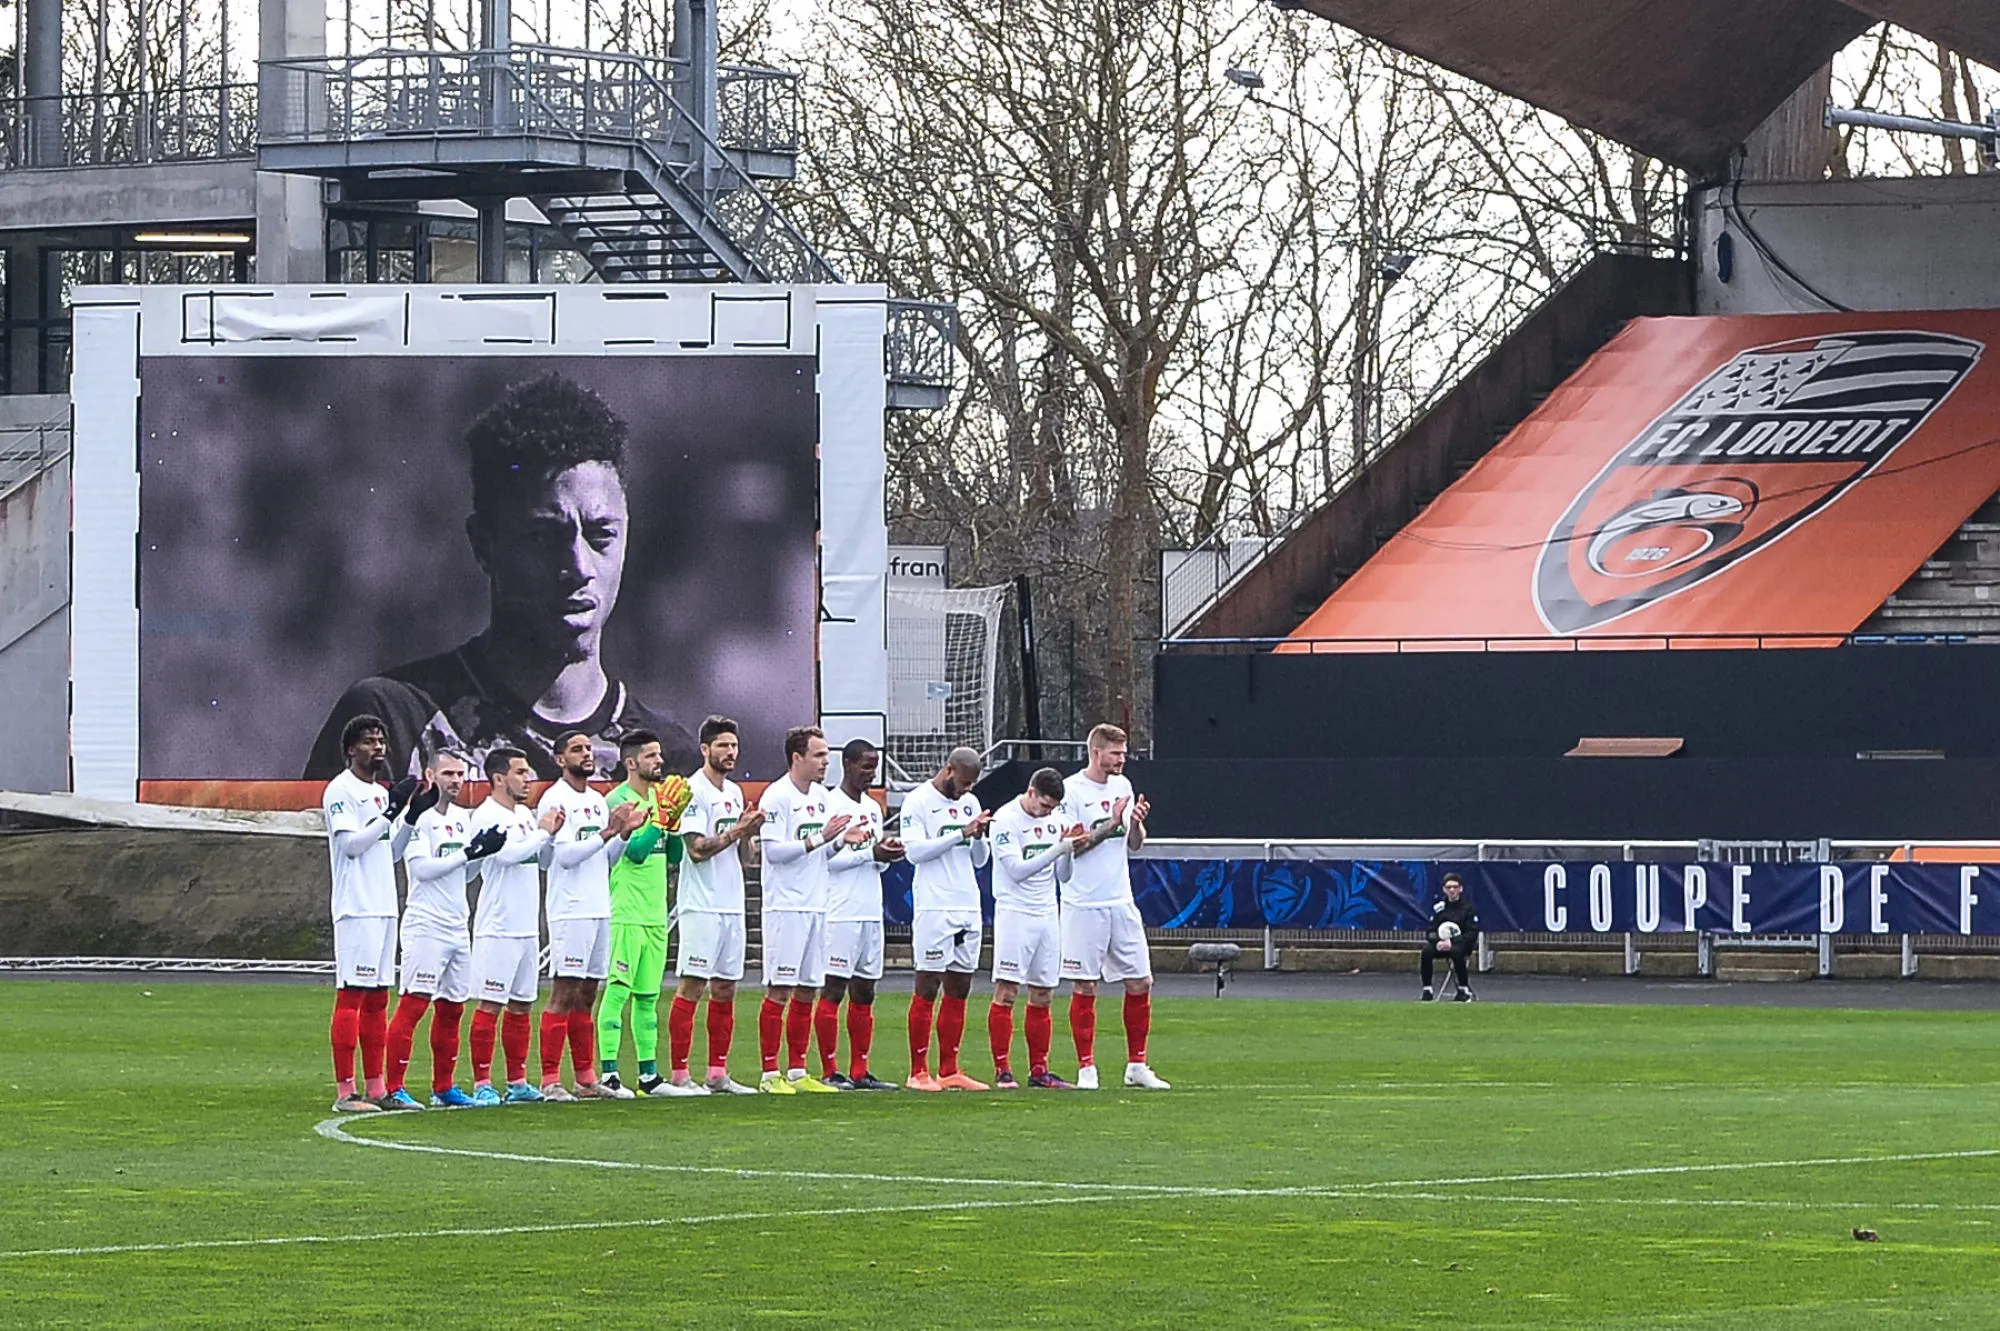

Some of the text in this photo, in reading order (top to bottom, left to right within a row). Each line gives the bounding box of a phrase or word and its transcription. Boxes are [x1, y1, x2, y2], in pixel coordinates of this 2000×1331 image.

[1629, 418, 1911, 458] FC LORIENT
[889, 556, 945, 576] fran
[1543, 864, 1752, 933] COUPE
[1819, 865, 1890, 934] DE
